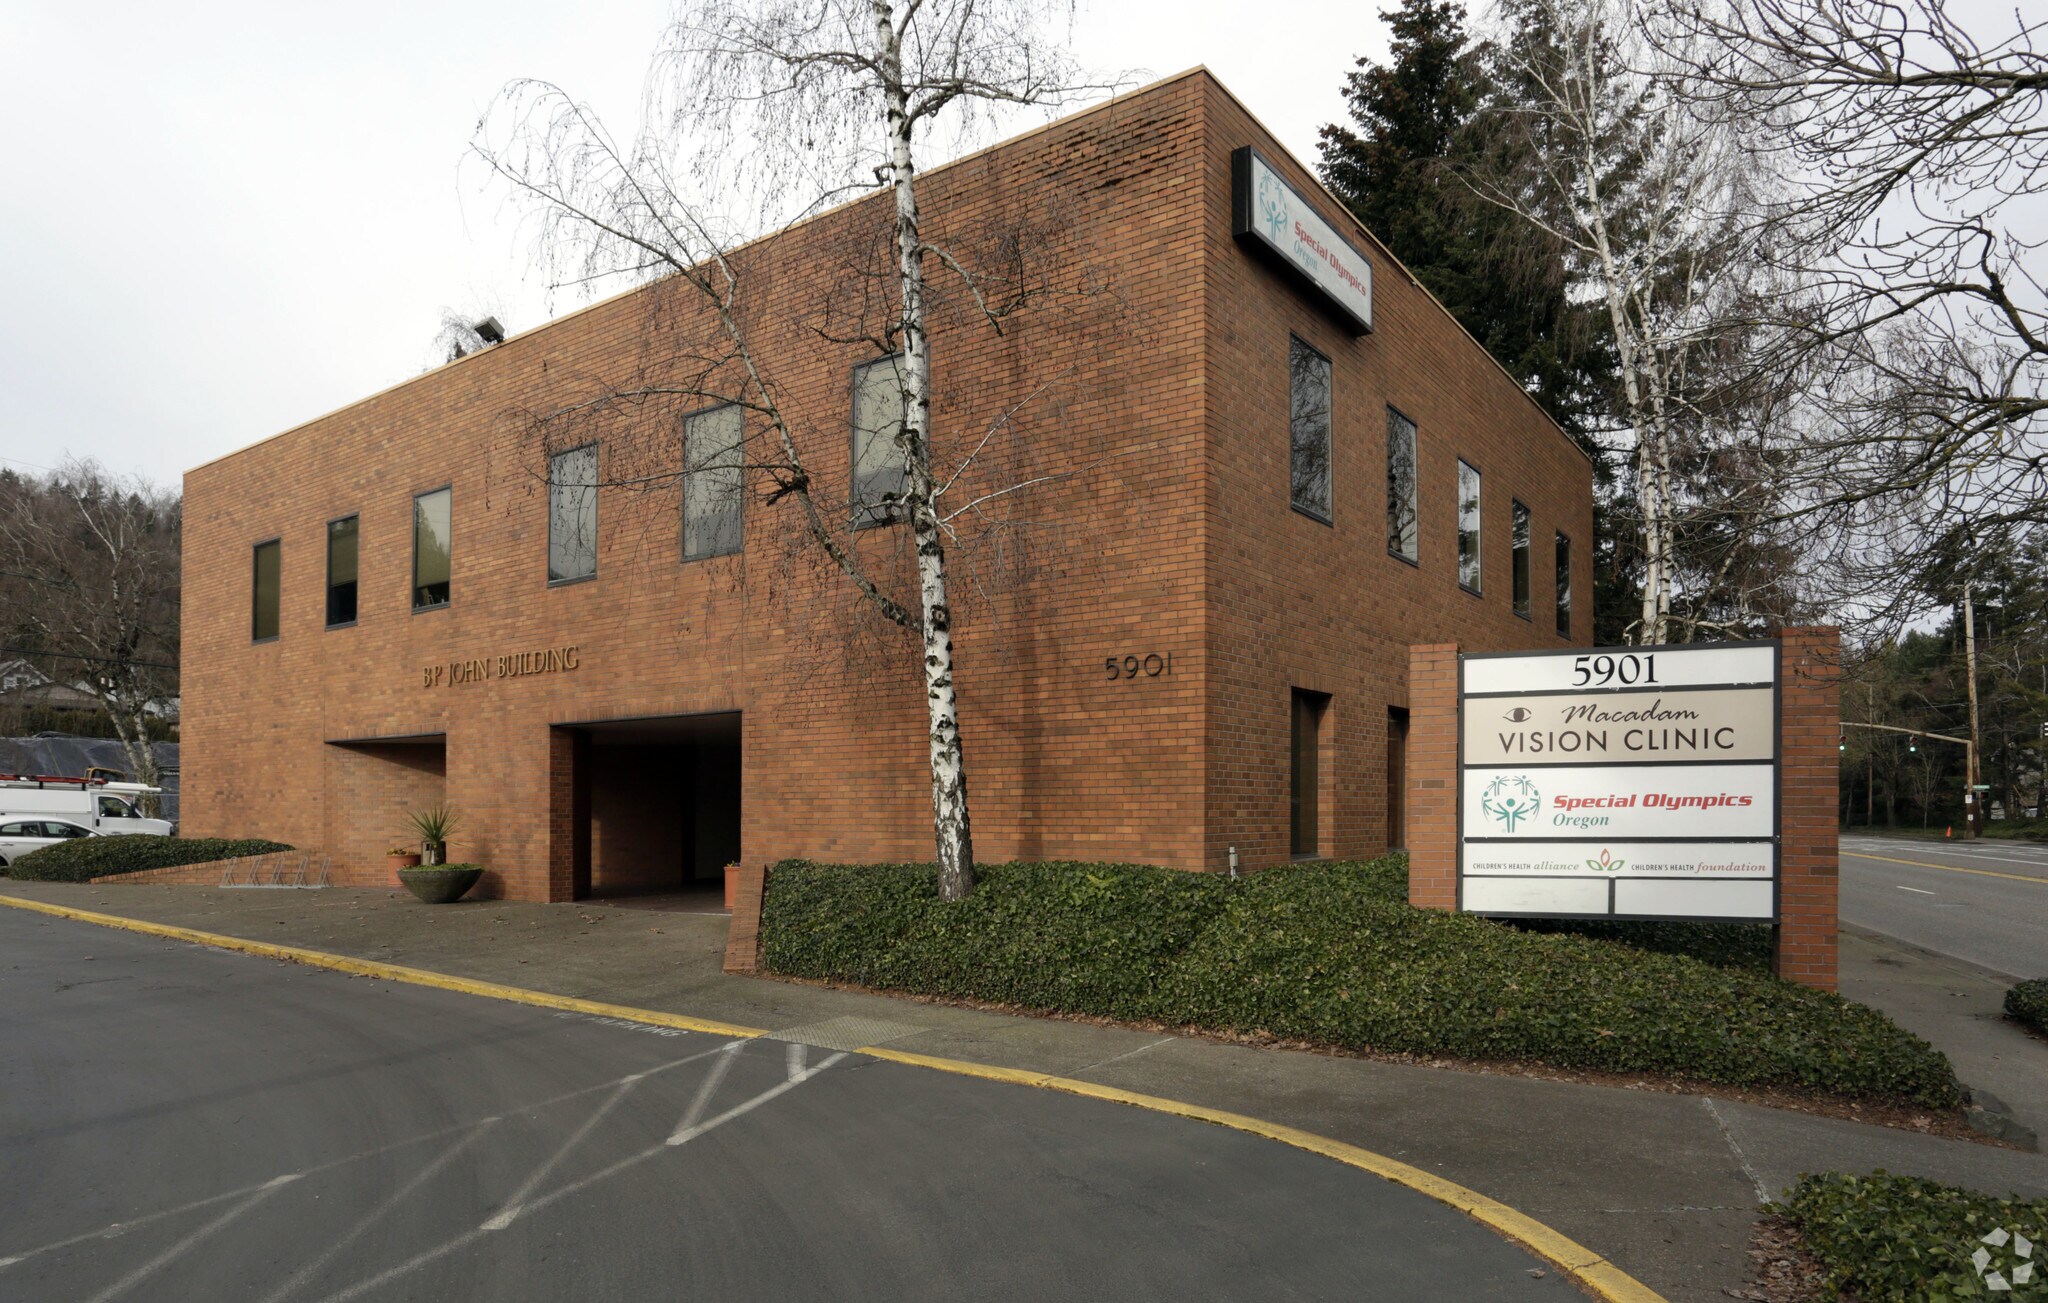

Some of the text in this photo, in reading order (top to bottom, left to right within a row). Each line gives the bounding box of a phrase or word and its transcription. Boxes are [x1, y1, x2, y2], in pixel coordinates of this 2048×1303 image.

[1294, 240, 1318, 271] Oregon
[1295, 220, 1366, 296] Special Olympics
[448, 658, 490, 687] JOHN
[497, 646, 580, 677] BUILDING
[1105, 651, 1171, 680] 5901
[1572, 654, 1659, 686] 5901
[1561, 699, 1699, 723] Macadam
[1498, 727, 1735, 754] VISION CLINIC
[1553, 793, 1753, 811] Special Olympics
[1553, 813, 1609, 829] Oregon
[1472, 861, 1580, 871] CHILDREN'S HEALTH alliance
[1631, 862, 1766, 874] CHILDREN'S HEALTH foundation
